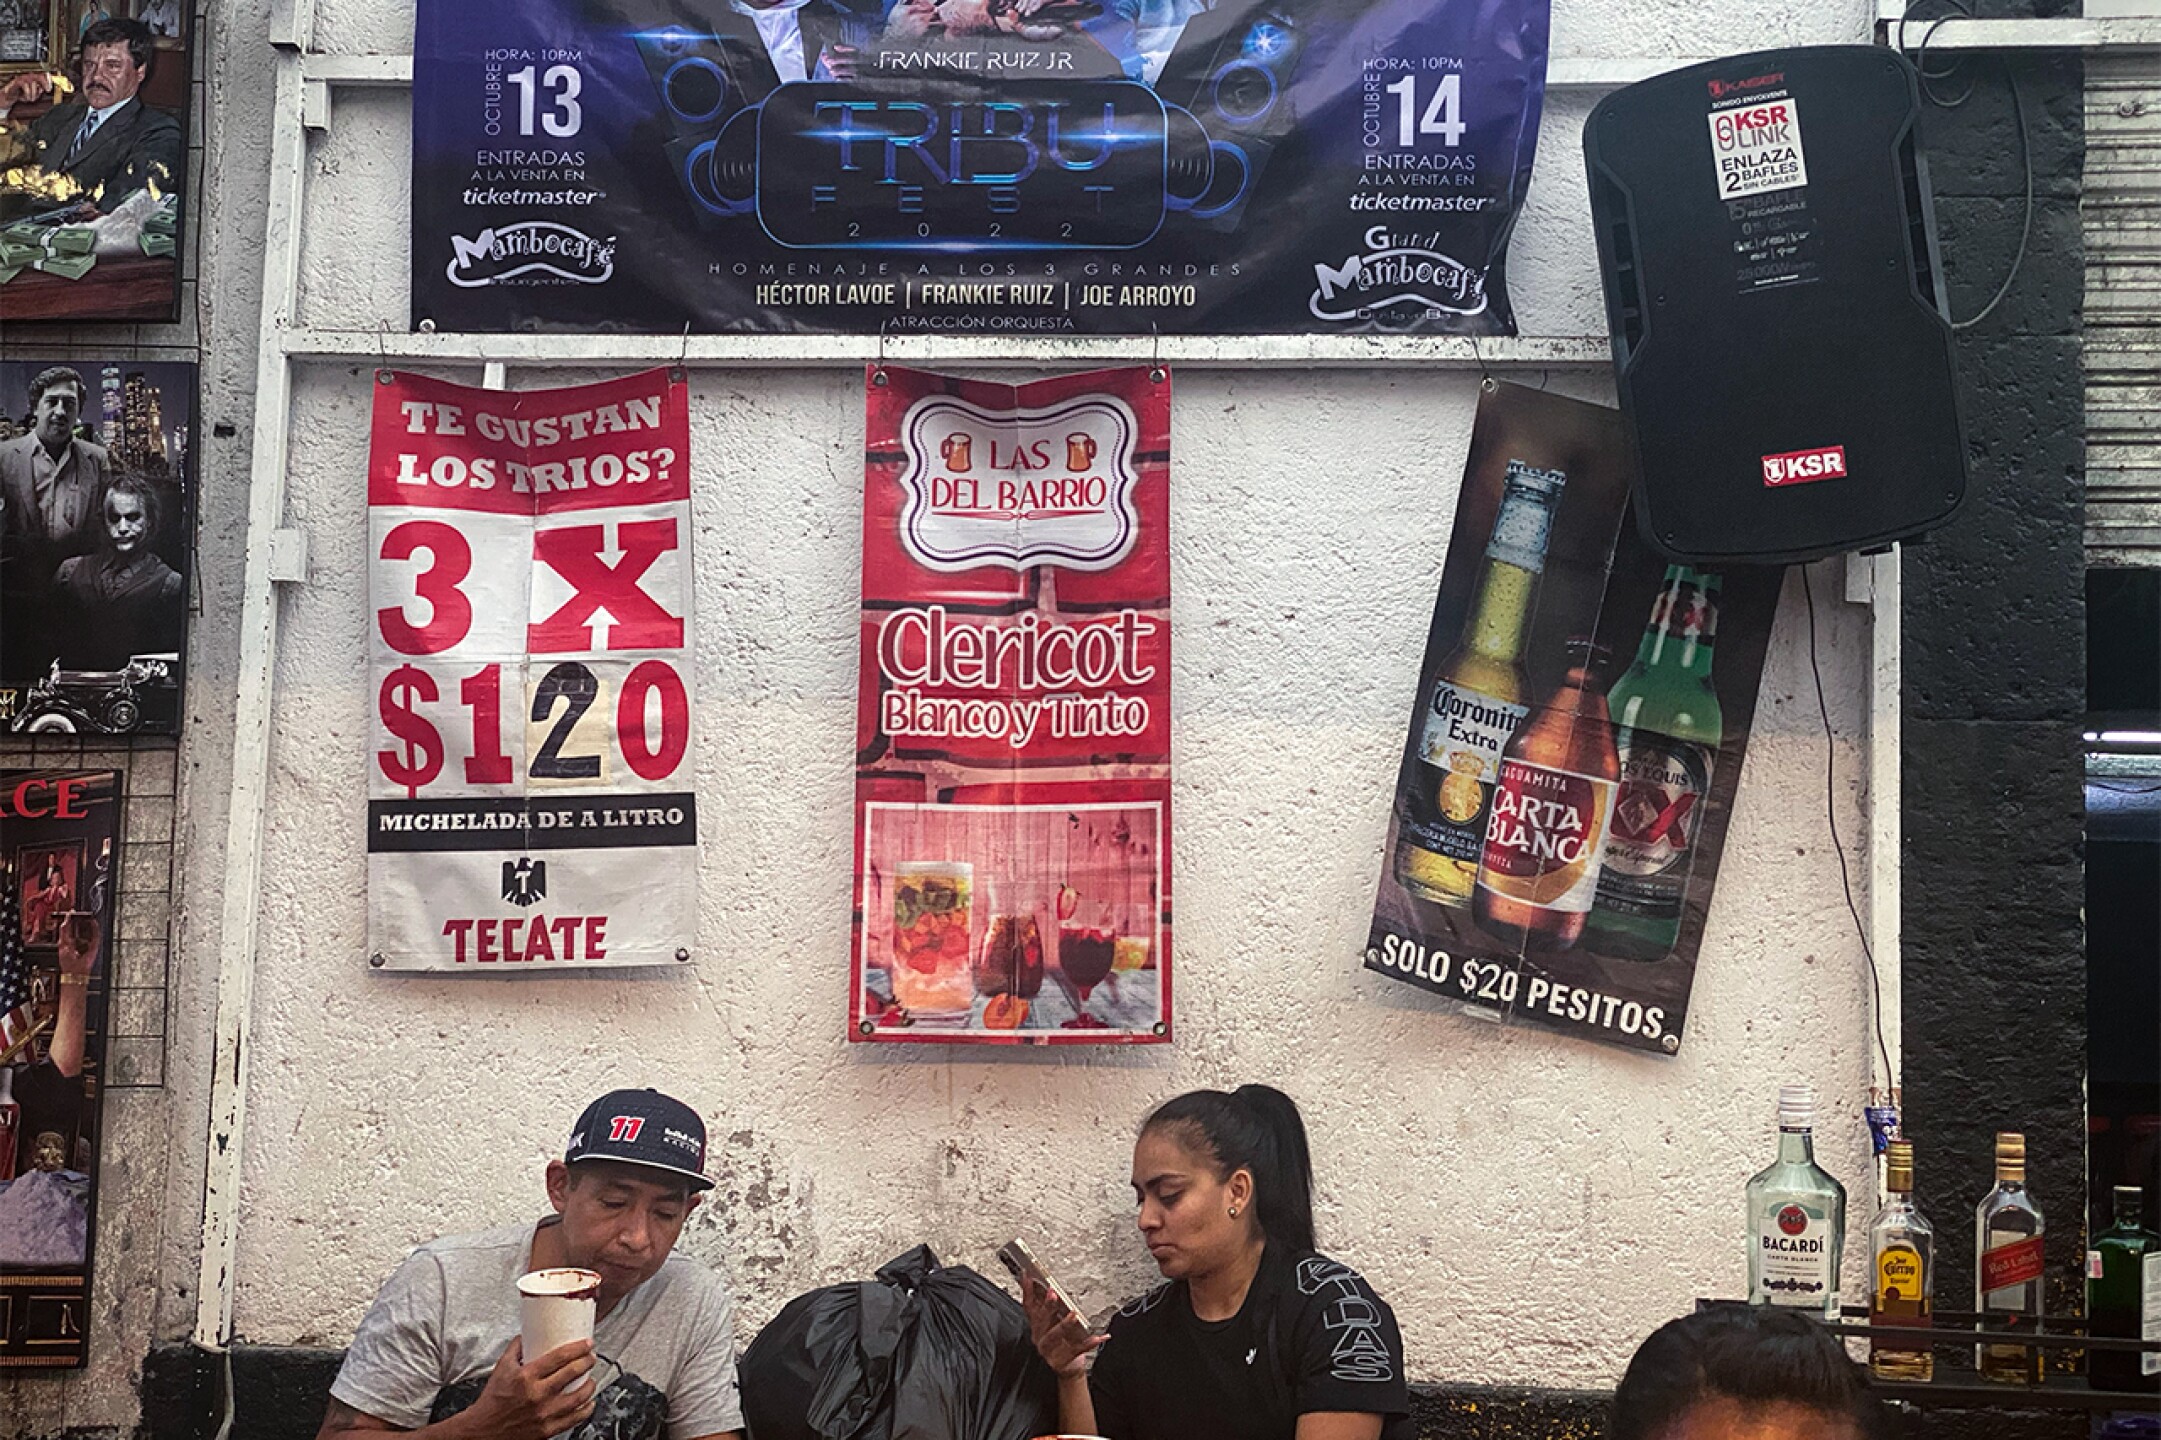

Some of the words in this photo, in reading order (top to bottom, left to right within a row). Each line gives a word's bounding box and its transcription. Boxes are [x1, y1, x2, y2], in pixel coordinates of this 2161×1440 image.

[485, 49, 535, 61] HORA:
[541, 49, 582, 61] 10PM
[879, 51, 978, 70] FRANKIE
[986, 51, 1040, 69] RUIZ
[1045, 52, 1073, 70] JR
[1363, 57, 1415, 70] HORA:
[1421, 57, 1463, 70] 10PM
[485, 63, 501, 136] OCTUBRE
[507, 65, 582, 137] 13
[1363, 73, 1381, 147] OCTUBRE
[1386, 74, 1467, 147] 14
[1734, 105, 1789, 131] KSR
[813, 102, 1115, 185] TRIBU
[1737, 124, 1791, 148] LINK
[477, 151, 585, 166] ENTRADAS
[1365, 154, 1476, 170] ENTRADAS
[1721, 147, 1797, 172] ENLAZA
[470, 169, 482, 181] A
[487, 169, 506, 181] LA
[510, 169, 559, 181] VENTA
[564, 169, 585, 181] EN
[1358, 174, 1370, 185] A
[1375, 174, 1395, 185] LA
[1400, 174, 1450, 185] VENTA
[1455, 174, 1475, 185] EN
[1725, 172, 1742, 192] 2
[1742, 162, 1798, 181] BAFLES
[462, 186, 598, 205] ticketmaster
[811, 186, 1114, 213] FEST
[1350, 192, 1487, 211] ticketmaster
[849, 222, 1073, 237] 2022
[708, 263, 888, 275] HOMENAJE
[917, 263, 930, 275] A
[959, 263, 1016, 276] LOS
[1045, 263, 1055, 275] 3
[1083, 263, 1240, 276] GRANDES
[756, 280, 830, 305] HÉCTOR
[836, 284, 896, 305] LAVOE
[921, 284, 1005, 305] FRANKIE
[1010, 284, 1054, 305] RUIZ
[1080, 285, 1114, 306] JOE
[1119, 285, 1197, 306] ARROYO
[889, 313, 985, 328] ATRACCIÓN
[990, 316, 1075, 329] ORQUESTA
[401, 401, 466, 435] TE
[475, 396, 662, 448] GUSTAN
[990, 439, 1052, 471] LAS
[1786, 452, 1844, 479] KSR
[396, 453, 496, 490] LOS
[506, 448, 676, 494] TRIOS?
[931, 477, 992, 509] DEL
[998, 475, 1107, 511] BARRIO
[377, 520, 473, 655] 3
[526, 517, 685, 654] X
[879, 606, 1155, 690] Clericot
[377, 660, 689, 799] $120
[882, 690, 1010, 737] Blanco
[1007, 700, 1040, 748] y
[1041, 692, 1150, 737] Tinto
[1448, 718, 1498, 751] Extra
[0, 779, 89, 818] CE
[1491, 785, 1583, 833] CARTA
[379, 810, 532, 831] MICHELADA
[537, 811, 575, 828] DE
[580, 810, 598, 827] A
[602, 808, 685, 827] LITRO
[442, 914, 608, 963] TECATE
[1381, 934, 1451, 984] SOLO
[1459, 958, 1519, 1003] $20
[1527, 976, 1664, 1040] PESITOS
[608, 1115, 646, 1142] 11
[1762, 1235, 1824, 1253] BACARDÍ
